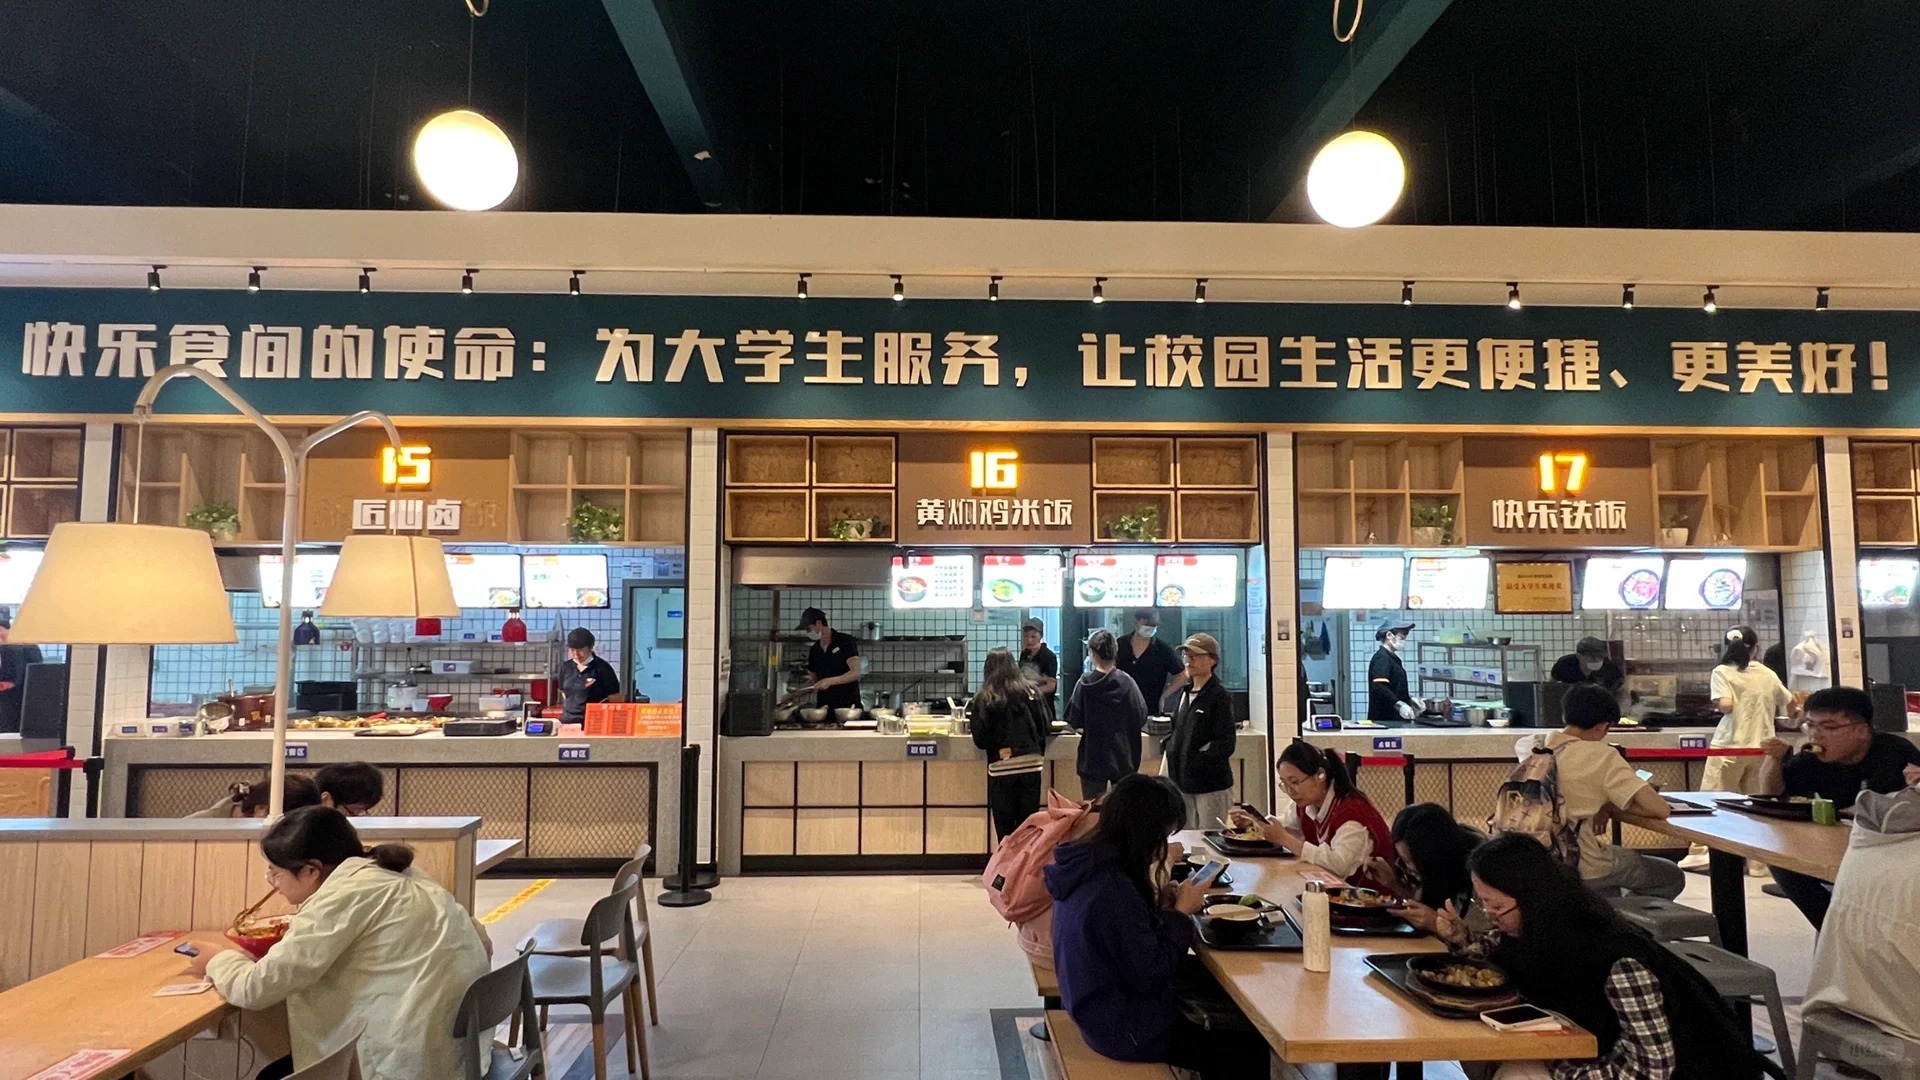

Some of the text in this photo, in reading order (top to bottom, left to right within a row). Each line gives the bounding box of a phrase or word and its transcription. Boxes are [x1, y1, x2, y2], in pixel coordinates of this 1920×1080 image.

[382, 446, 432, 485] 15
[970, 451, 1019, 489] 16
[1540, 455, 1588, 491] 17
[352, 499, 462, 530] 匠心卤
[916, 499, 1073, 526] 黄焖鸡米饭
[1492, 499, 1627, 529] 快乐铁板
[562, 749, 586, 758] 点餐区
